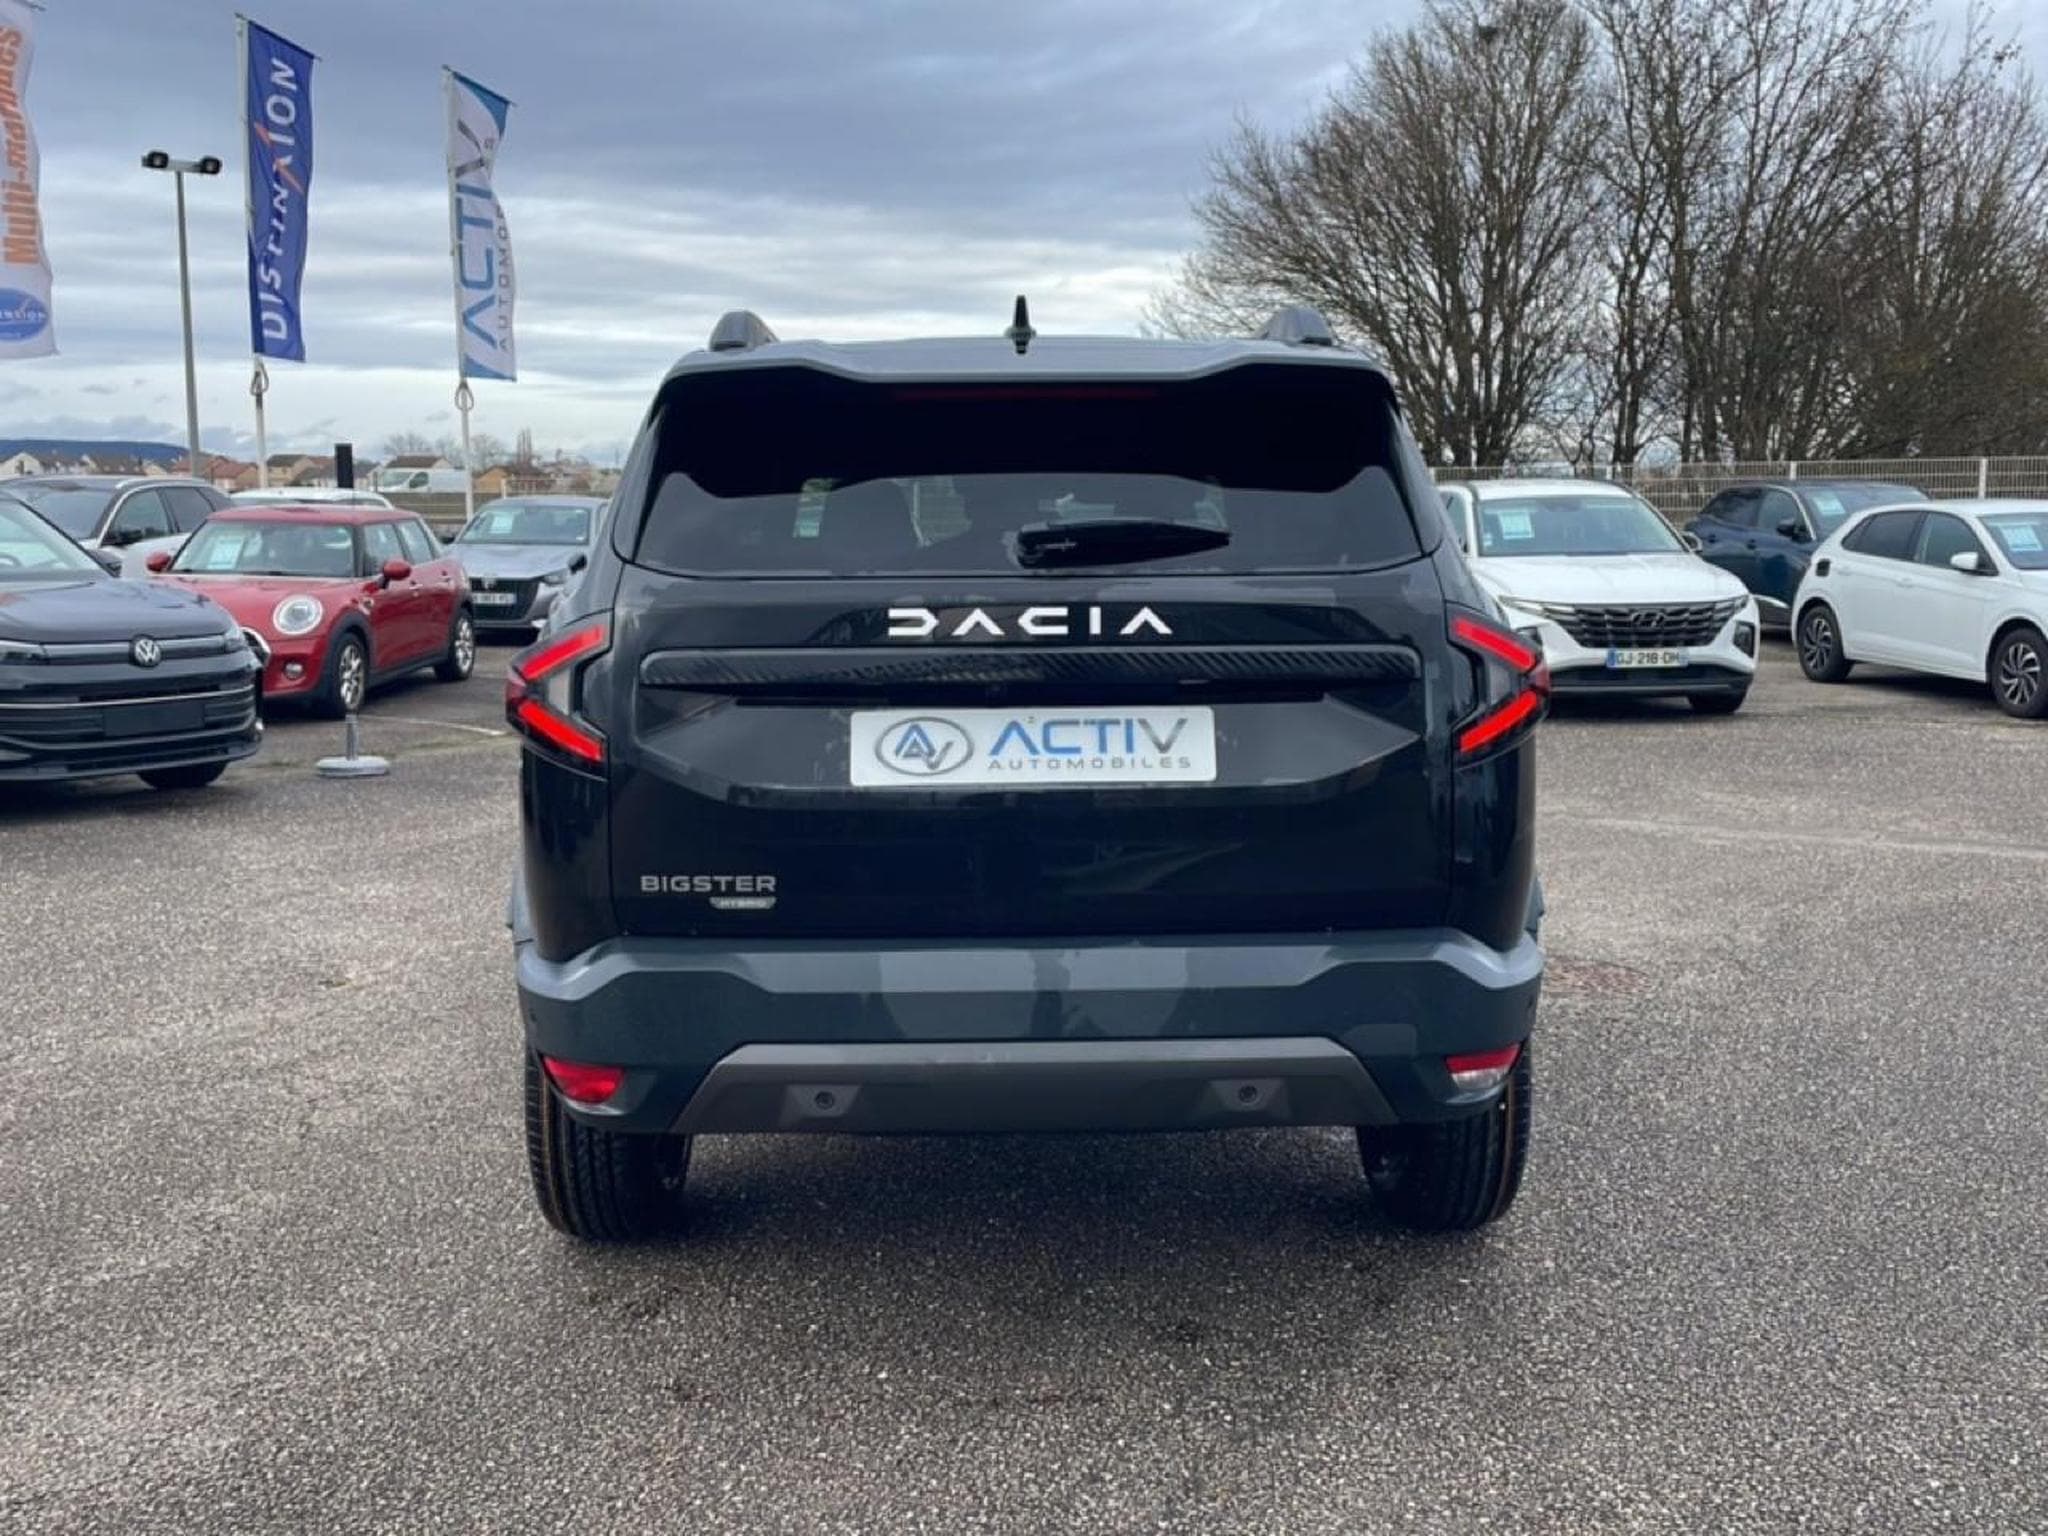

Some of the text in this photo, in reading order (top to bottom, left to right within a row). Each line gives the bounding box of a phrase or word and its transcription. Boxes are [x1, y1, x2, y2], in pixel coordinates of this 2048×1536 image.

[455, 118, 497, 350] ACTIV
[888, 606, 1173, 636] DACIA
[988, 717, 1188, 757] ACTIV
[987, 756, 1192, 770] AUTOMOBILES
[640, 875, 777, 892] BIGSTER
